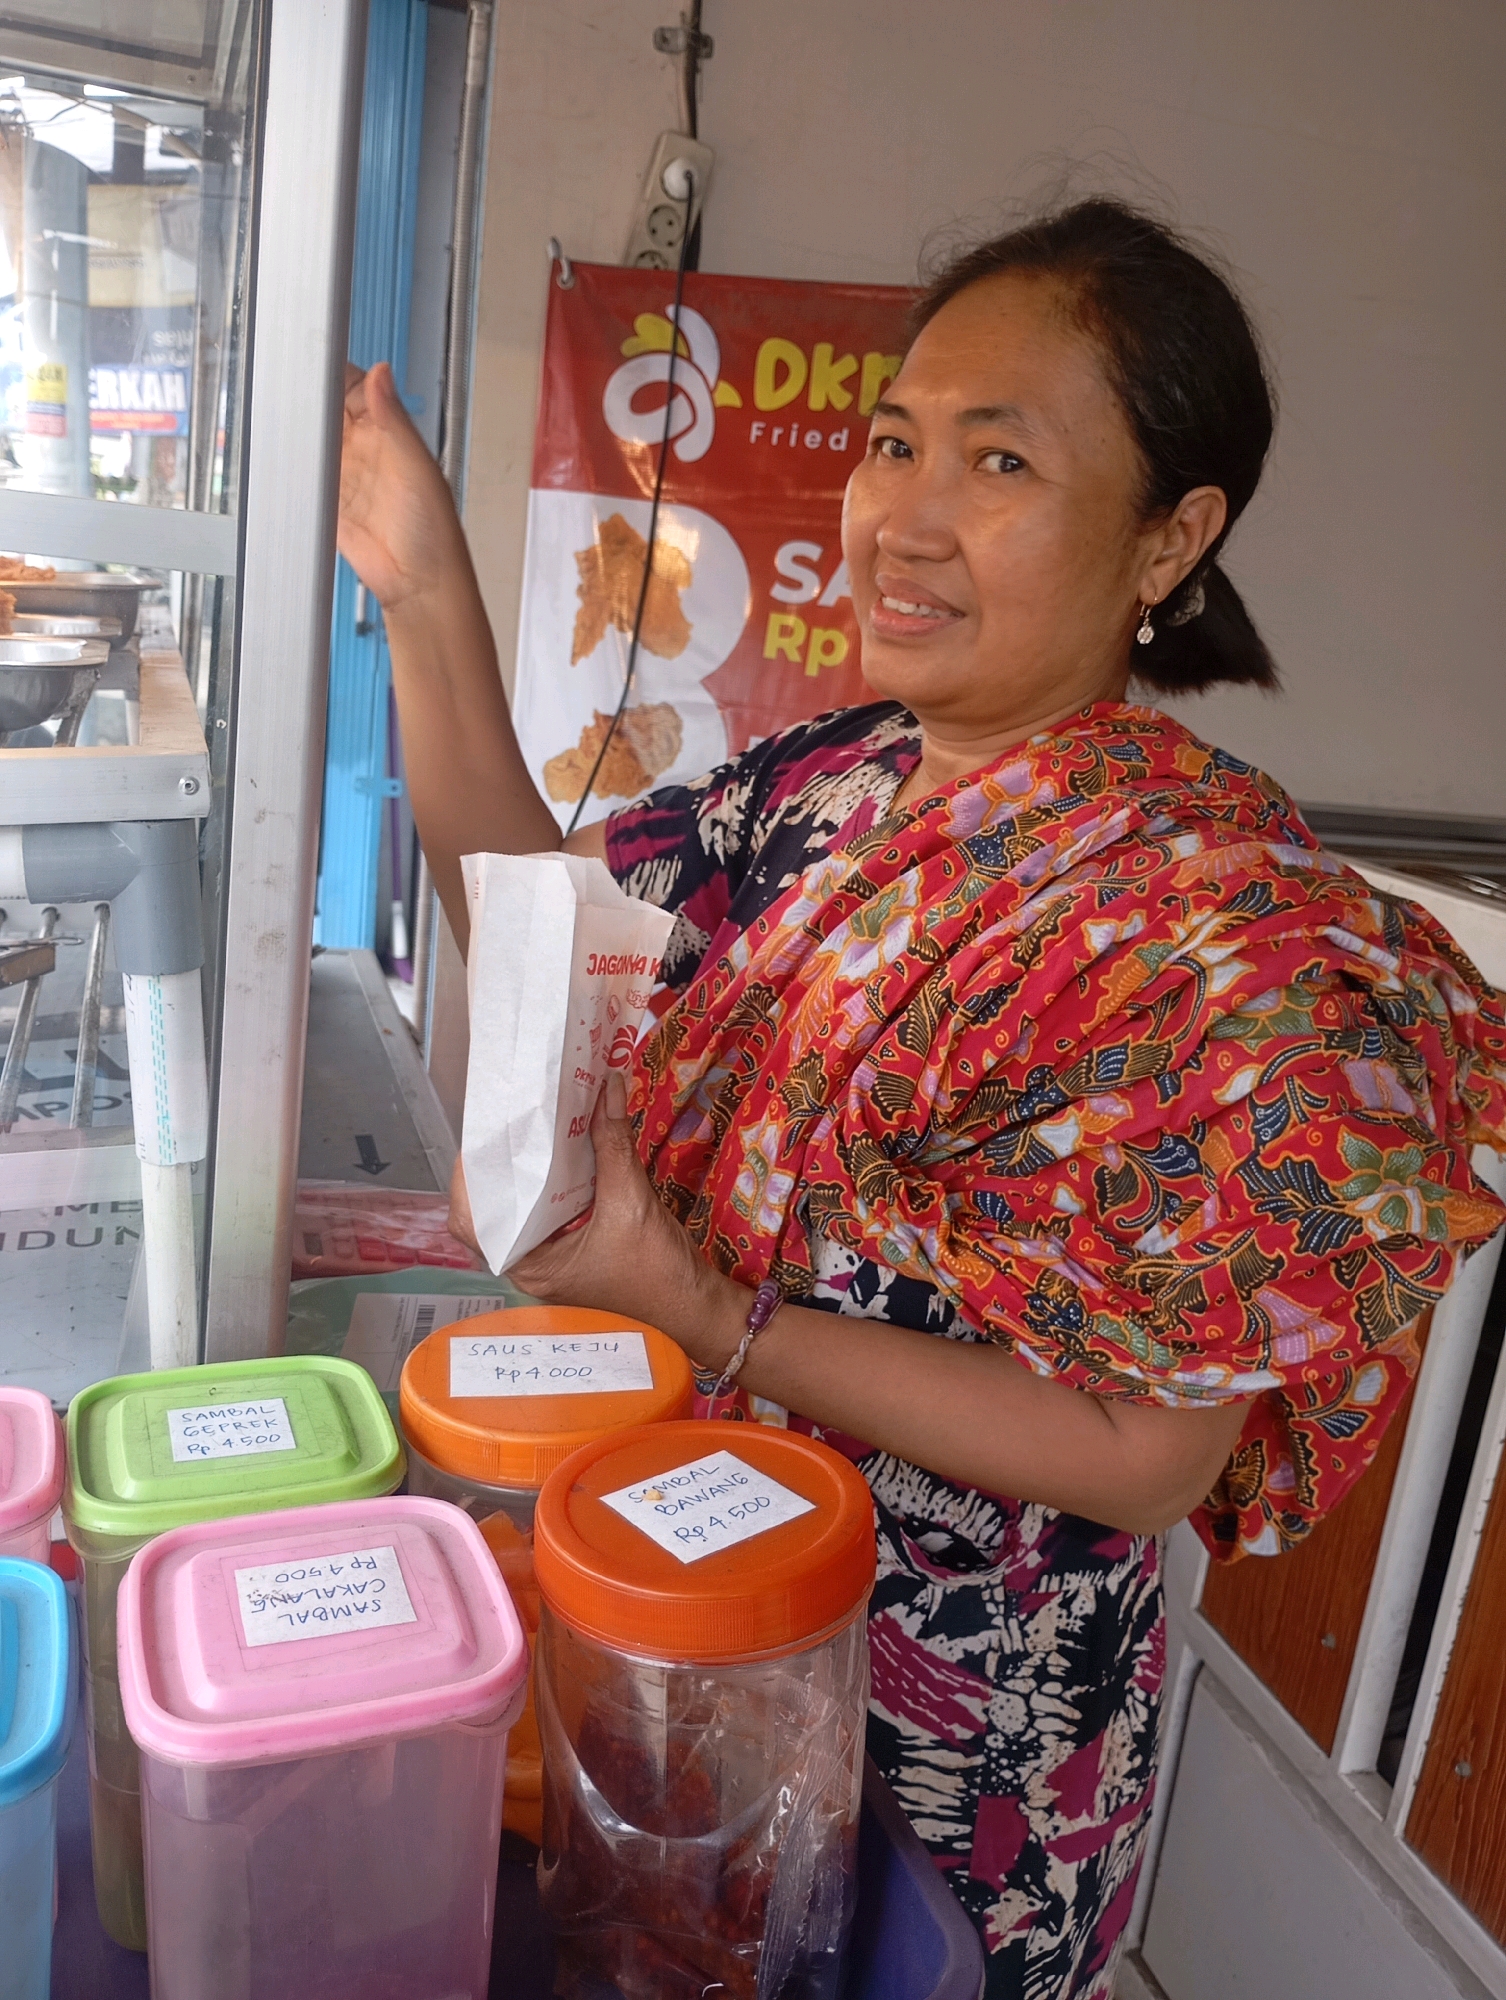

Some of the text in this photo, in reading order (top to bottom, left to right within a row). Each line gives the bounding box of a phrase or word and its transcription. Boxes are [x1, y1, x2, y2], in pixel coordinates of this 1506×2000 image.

[750, 420, 849, 451] Fried
[763, 612, 848, 677] Rp
[468, 1342, 620, 1357] SAUS KEJU
[181, 1406, 276, 1423] SAMBAL
[183, 1418, 278, 1437] GEPREK
[654, 1472, 749, 1516] BAWANG
[708, 1496, 771, 1530] 4.500
[278, 1599, 382, 1626] SAMBAL
